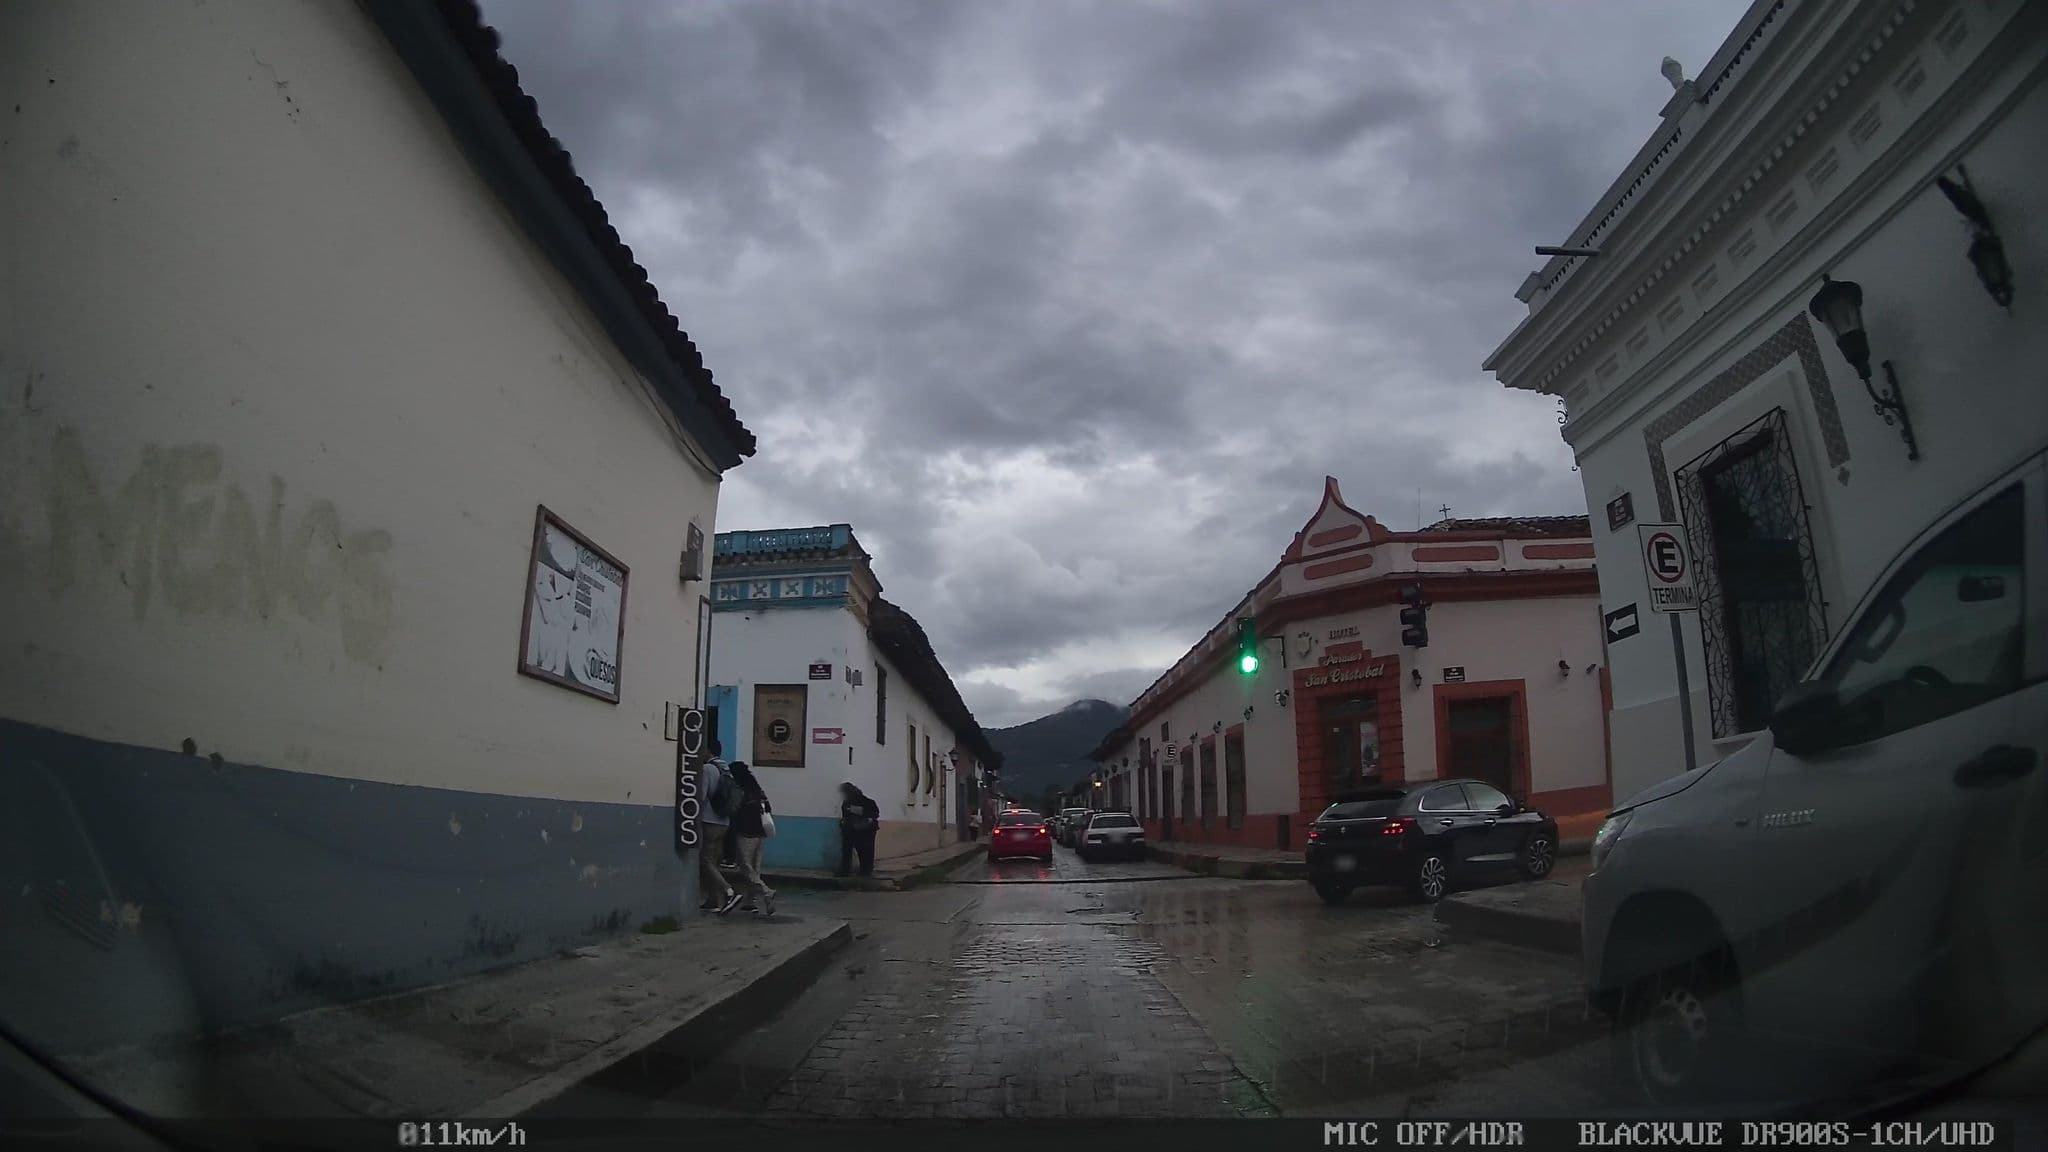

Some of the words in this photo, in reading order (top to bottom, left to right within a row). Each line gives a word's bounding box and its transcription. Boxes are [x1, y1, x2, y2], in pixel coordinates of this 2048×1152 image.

[1656, 541, 1679, 573] E
[1652, 587, 1696, 604] TERMINA
[591, 656, 616, 685] QUESOS
[1305, 673, 1328, 687] San
[680, 710, 703, 844] QUESOS
